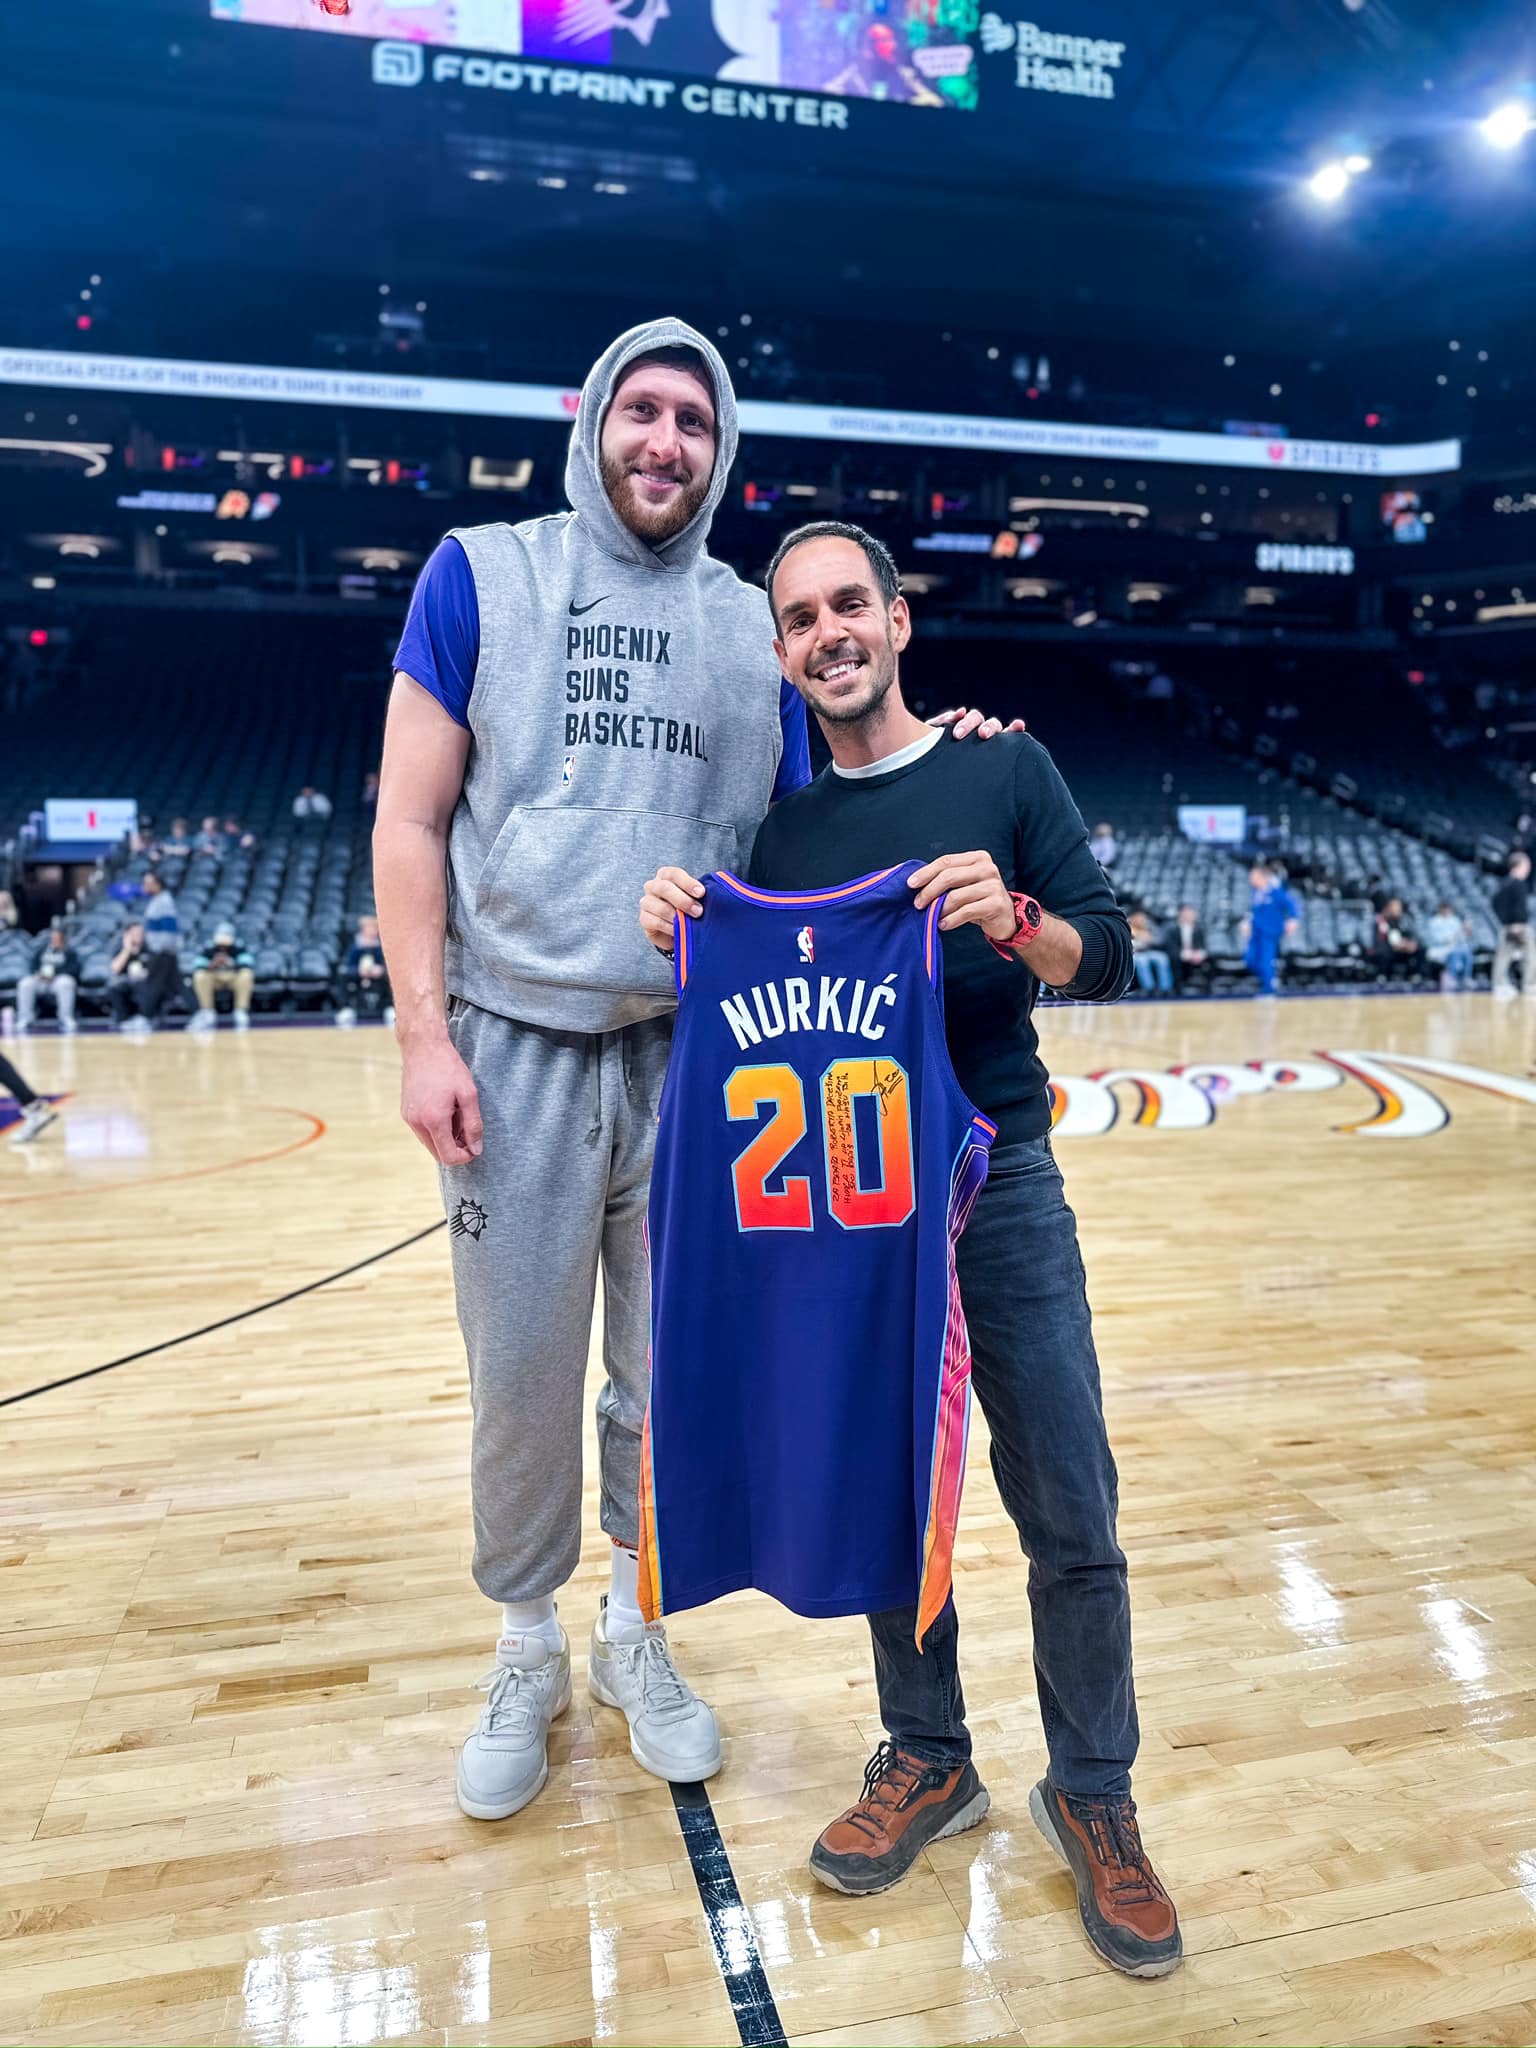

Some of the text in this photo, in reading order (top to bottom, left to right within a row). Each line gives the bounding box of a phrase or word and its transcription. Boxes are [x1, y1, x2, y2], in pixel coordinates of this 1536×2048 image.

[1015, 20, 1126, 68] Banner
[433, 54, 849, 130] FOOTPRINT CENTER
[1015, 54, 1115, 99] Health
[567, 624, 671, 665] PHOENIX
[566, 667, 629, 703] SUNS
[565, 711, 708, 762] BASKETBALL
[720, 973, 898, 1051] NURKIĆ
[723, 1056, 916, 1232] 20
